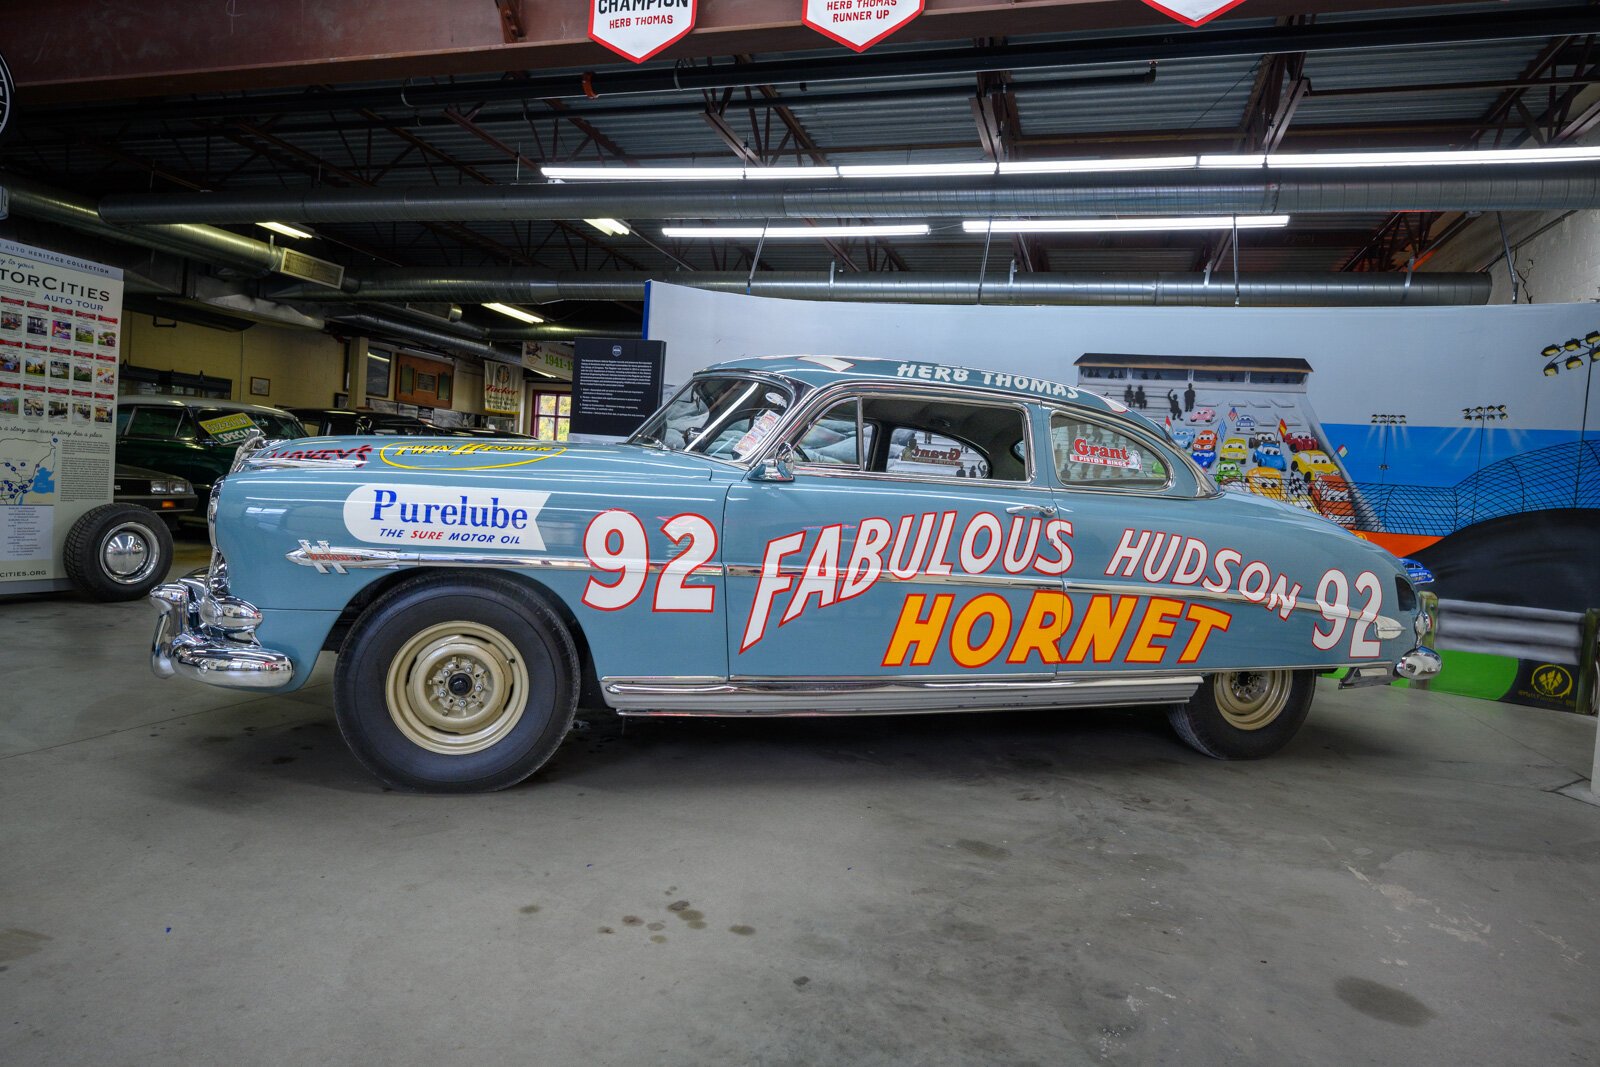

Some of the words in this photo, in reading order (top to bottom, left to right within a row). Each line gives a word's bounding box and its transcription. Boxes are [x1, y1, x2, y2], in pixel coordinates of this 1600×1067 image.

[827, 1, 852, 10] HERB
[857, 0, 897, 8] THOMAS
[833, 11, 872, 22] RUNNER
[876, 10, 890, 19] UP
[609, 17, 631, 29] HERB
[635, 15, 674, 26] THOMAS
[5, 245, 25, 253] AUTO
[28, 250, 64, 263] HERITAGE
[66, 259, 109, 274] COLLECTION
[44, 294, 73, 305] AUTO
[76, 300, 104, 312] TOUR
[897, 363, 969, 382] HERB
[980, 371, 1079, 399] THOMAS
[1074, 438, 1130, 461] Grant
[370, 489, 528, 530] Purelube
[378, 528, 405, 539] THE
[410, 530, 444, 541] SURE
[448, 532, 496, 543] MOTOR
[500, 535, 521, 545] OIL
[581, 508, 718, 613] 92
[740, 510, 1075, 653] FABULOUS
[1105, 528, 1302, 620] HUDSON
[1311, 568, 1383, 659] 92
[881, 590, 1232, 669] HORNET
